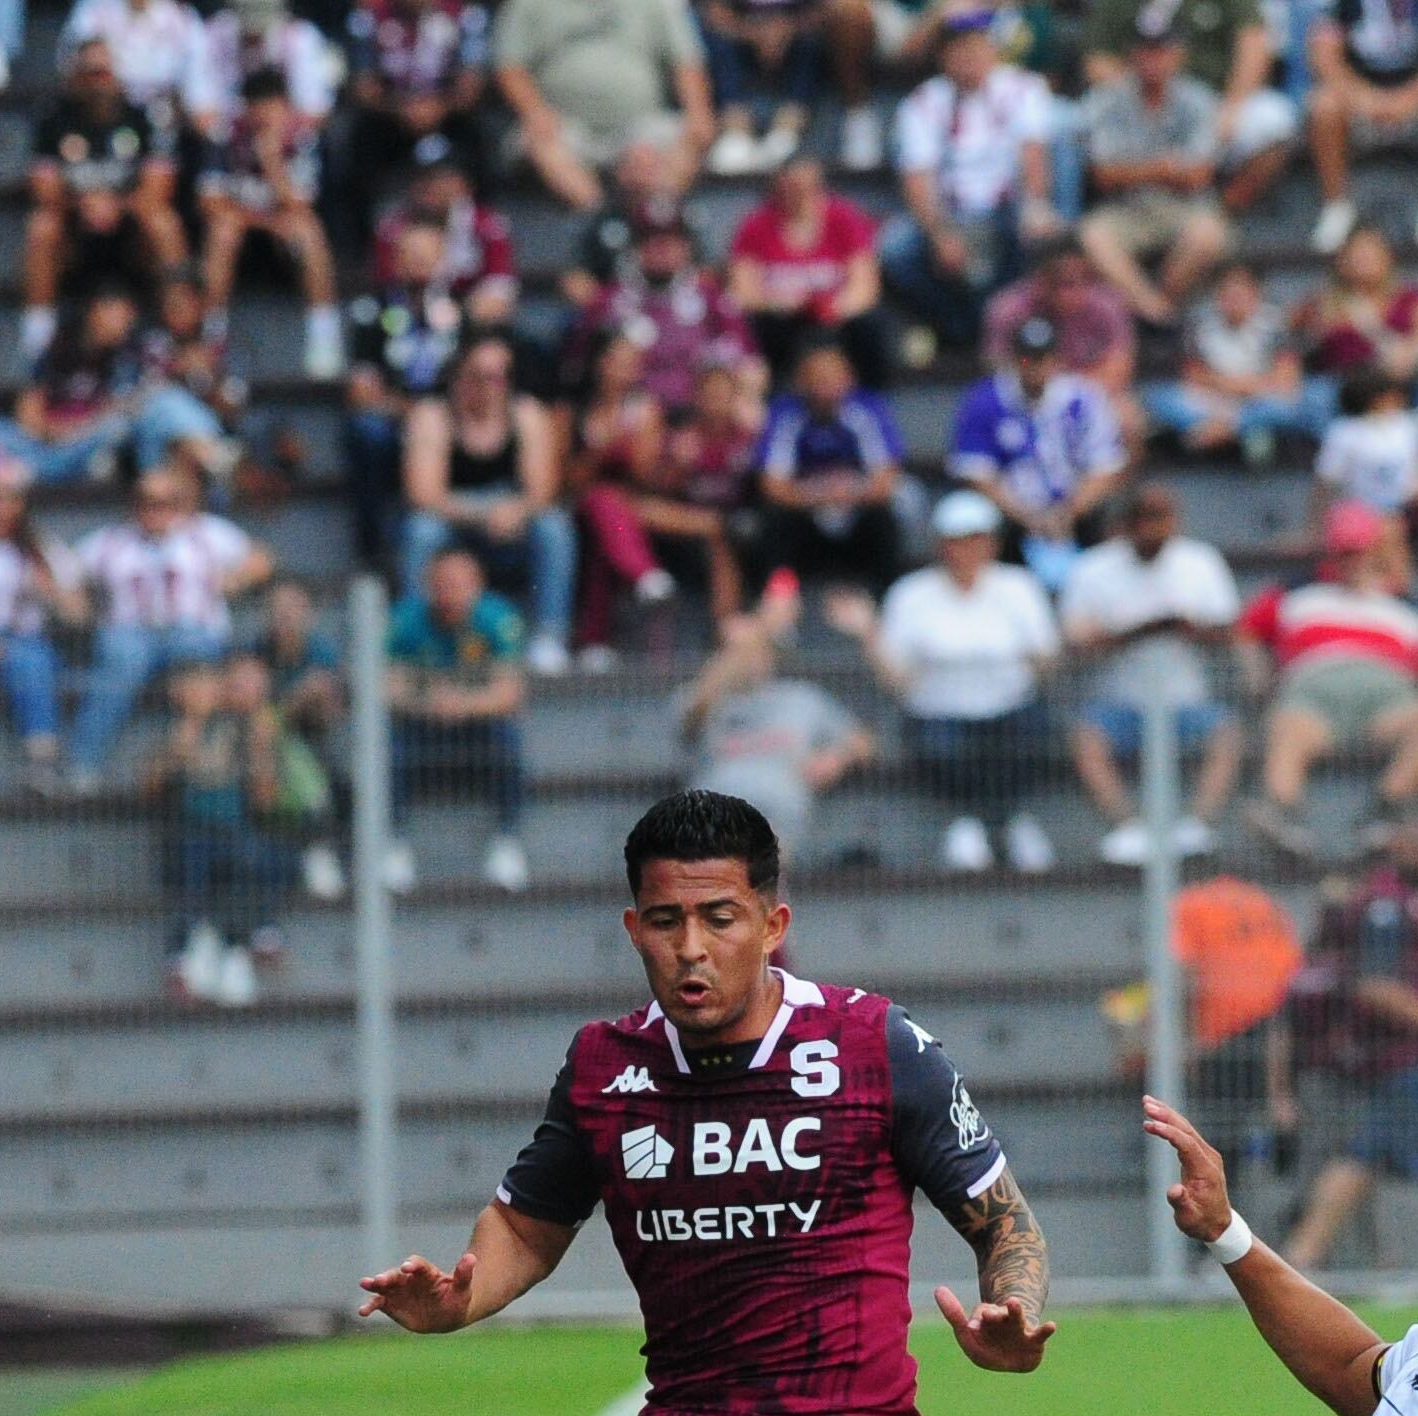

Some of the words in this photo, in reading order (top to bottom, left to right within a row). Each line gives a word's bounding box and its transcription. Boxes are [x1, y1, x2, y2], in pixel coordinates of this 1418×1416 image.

[789, 1039, 841, 1097] S
[692, 1117, 822, 1177] BAC
[635, 1199, 822, 1242] LIBERTY
